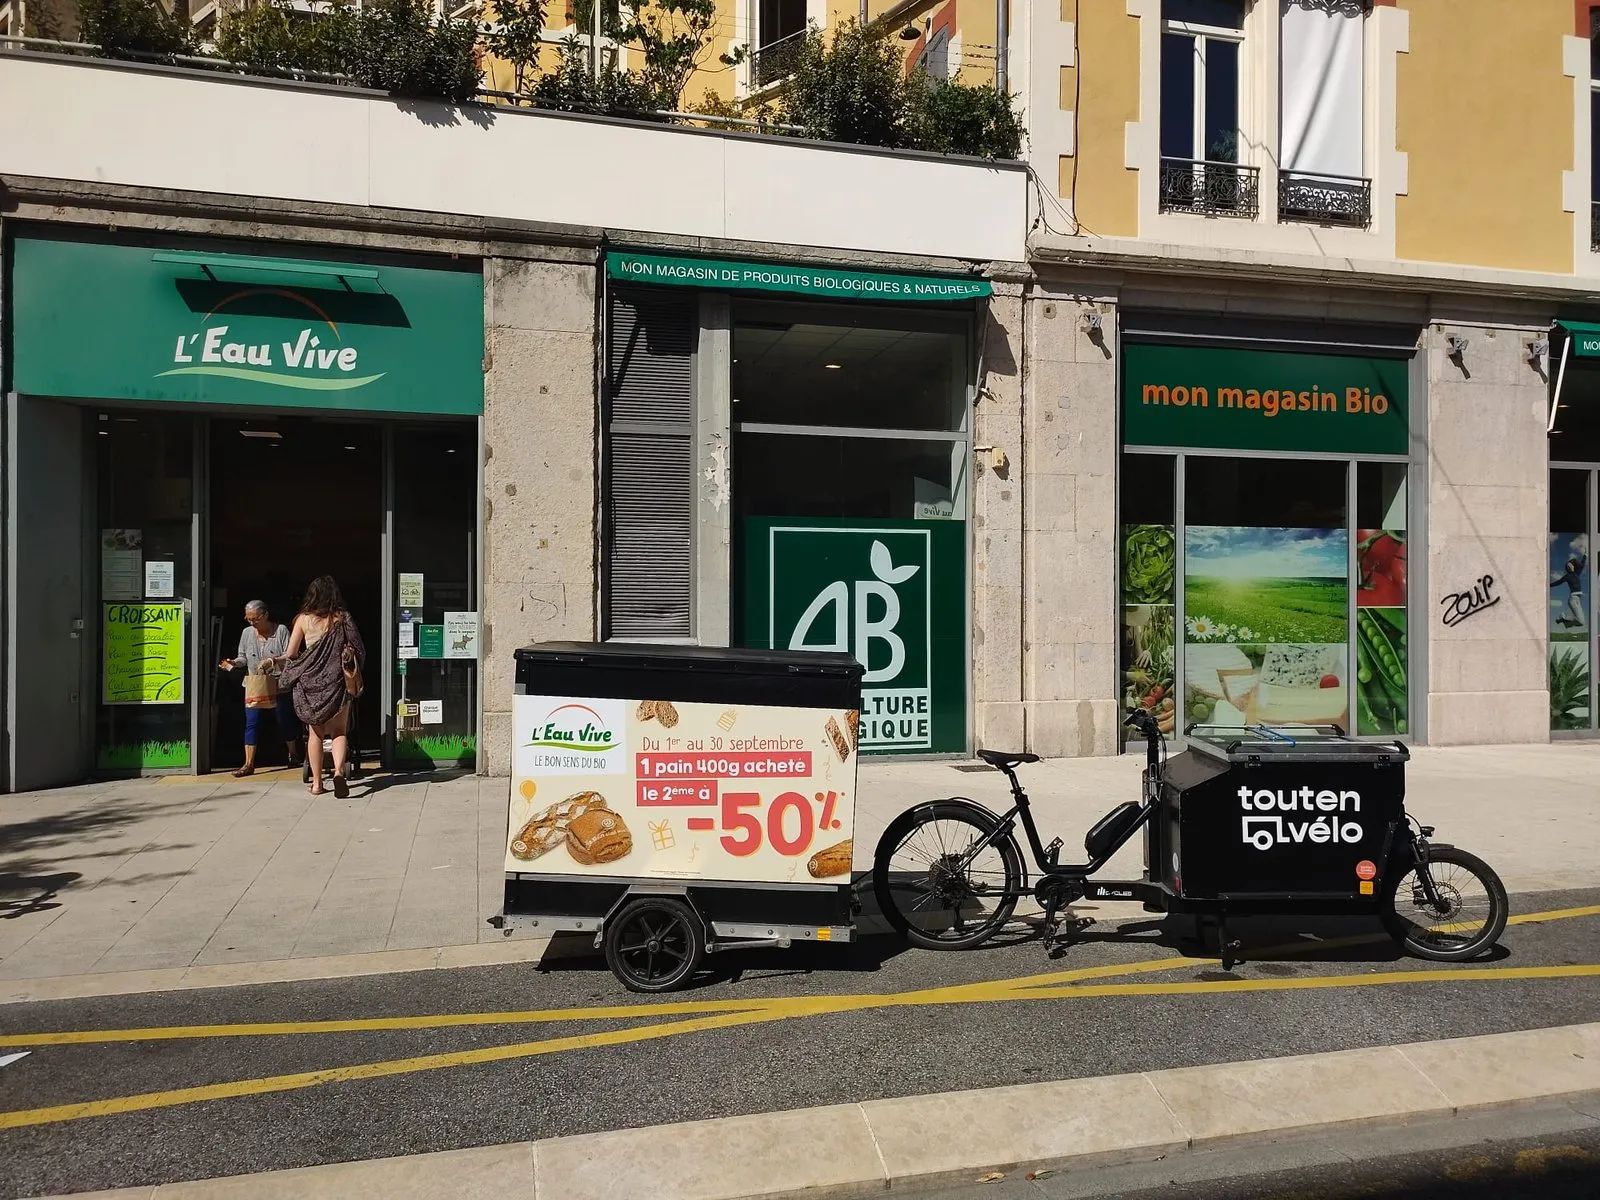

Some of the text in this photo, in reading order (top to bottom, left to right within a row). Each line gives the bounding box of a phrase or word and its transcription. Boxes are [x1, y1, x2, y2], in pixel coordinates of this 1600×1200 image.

[621, 261, 981, 294] MON MAGASIN DE PRODUITS BIOLOGIQUES & NATURELS
[174, 326, 357, 371] L'Eau Vive
[1583, 341, 1600, 351] MO
[1142, 384, 1389, 417] mon magasin Bio
[108, 605, 181, 624] CROISSANT
[788, 580, 906, 683] AB
[860, 696, 928, 715] LTURE
[532, 723, 612, 742] L'Eau Vive
[858, 719, 928, 739] GIQUE
[643, 736, 660, 751] Du
[686, 739, 704, 751] au
[710, 736, 723, 751] 30
[730, 735, 804, 752] septembre
[534, 755, 606, 769] LE BON SENS DU BIO
[640, 758, 806, 777] 1 pain 400g acheté
[643, 786, 659, 801] le
[698, 784, 711, 800] à
[1237, 786, 1361, 812] touten
[1288, 816, 1363, 843] vélo
